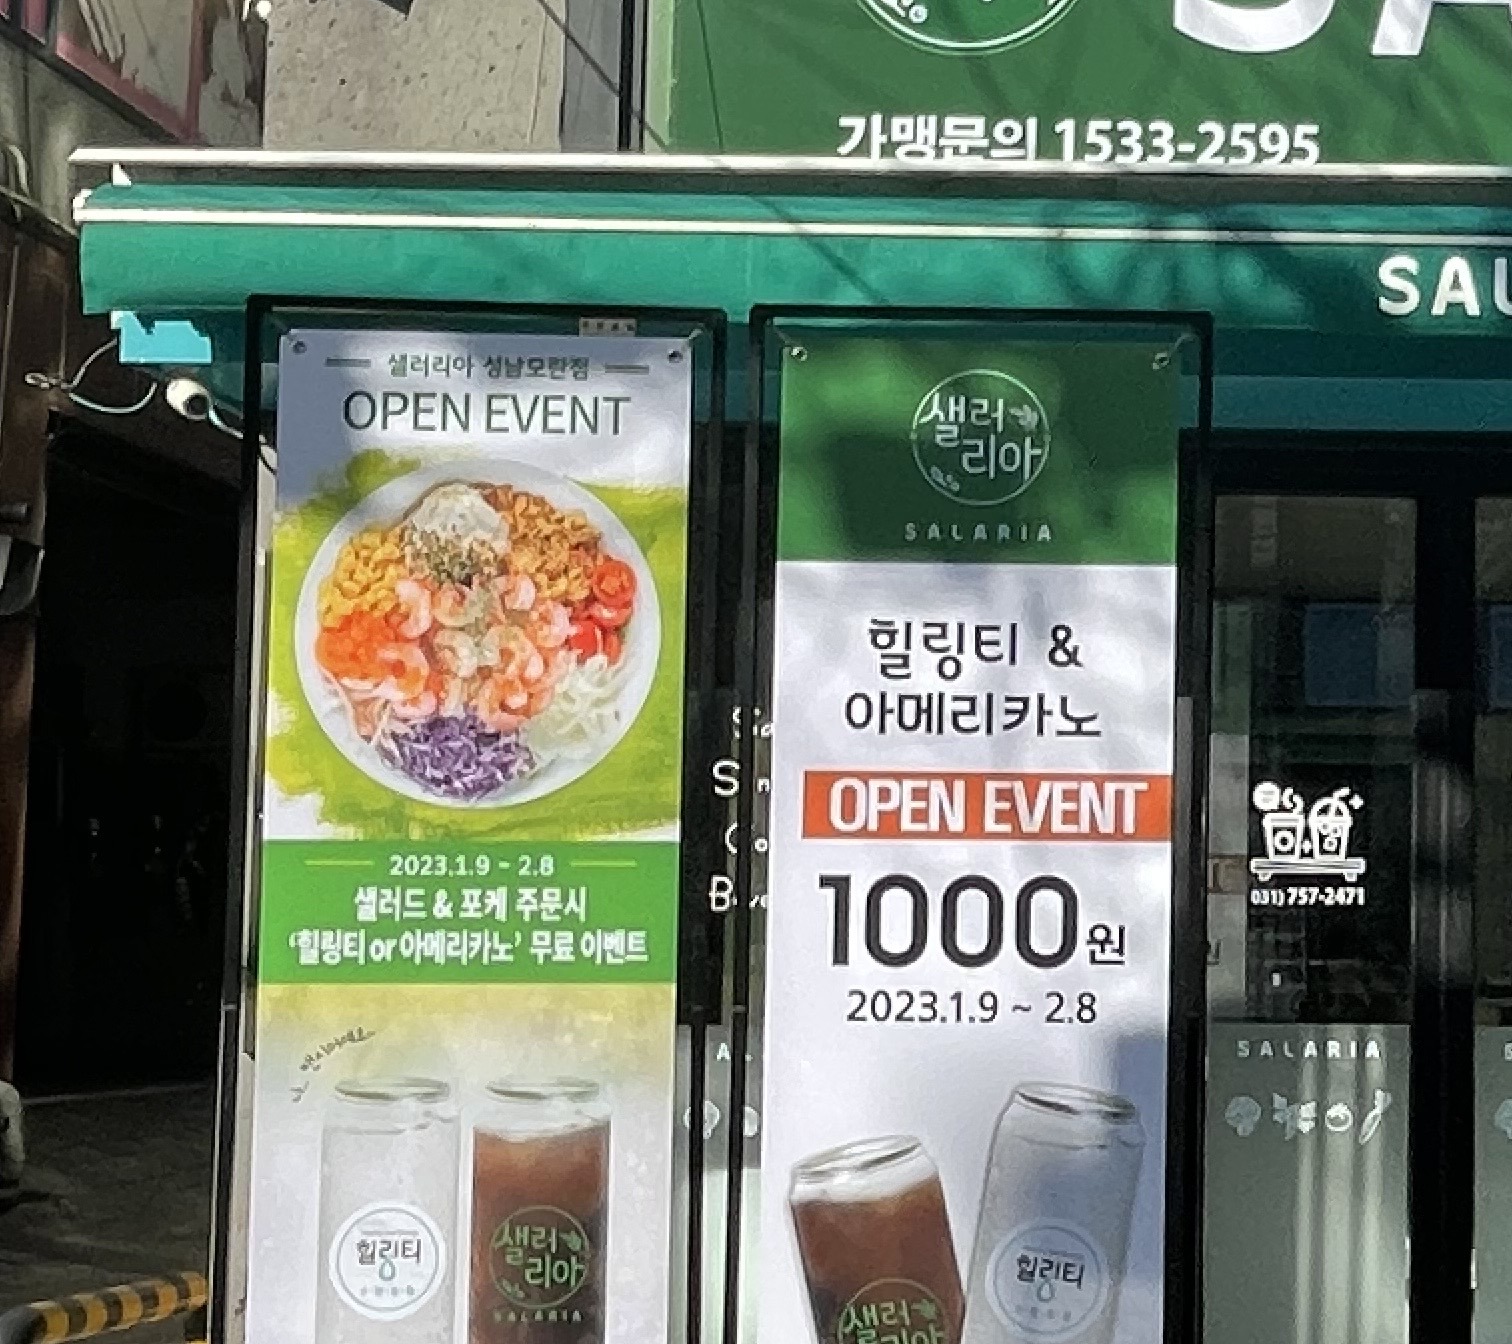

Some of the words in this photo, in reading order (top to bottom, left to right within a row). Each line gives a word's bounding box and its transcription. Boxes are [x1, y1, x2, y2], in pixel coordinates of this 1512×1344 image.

[836, 112, 1036, 161] 가맹문의
[1053, 118, 1320, 166] 1533-2595
[343, 390, 470, 432] OPEN
[486, 392, 631, 435] EVENT
[918, 392, 1004, 448] 샐러
[962, 433, 1042, 482] 리아
[904, 521, 1052, 543] SALARIA
[868, 619, 1019, 681] 힐링티
[1048, 624, 1084, 669] &
[845, 691, 1102, 739] 아메리카노
[829, 777, 966, 834] OPEN
[983, 779, 1149, 836] EVENT
[389, 854, 490, 876] 2023.1.9
[518, 854, 554, 876] 2.8
[432, 888, 453, 920] &
[458, 886, 508, 923] 포케
[515, 886, 588, 923] 주문시
[369, 938, 397, 962] or
[529, 929, 576, 966] 무료
[580, 928, 650, 966] 이벤트
[846, 989, 999, 1025] 2023.1.9
[1045, 990, 1098, 1025] 2.8
[1237, 1040, 1382, 1059] SALARIA
[524, 1254, 586, 1289] 리아
